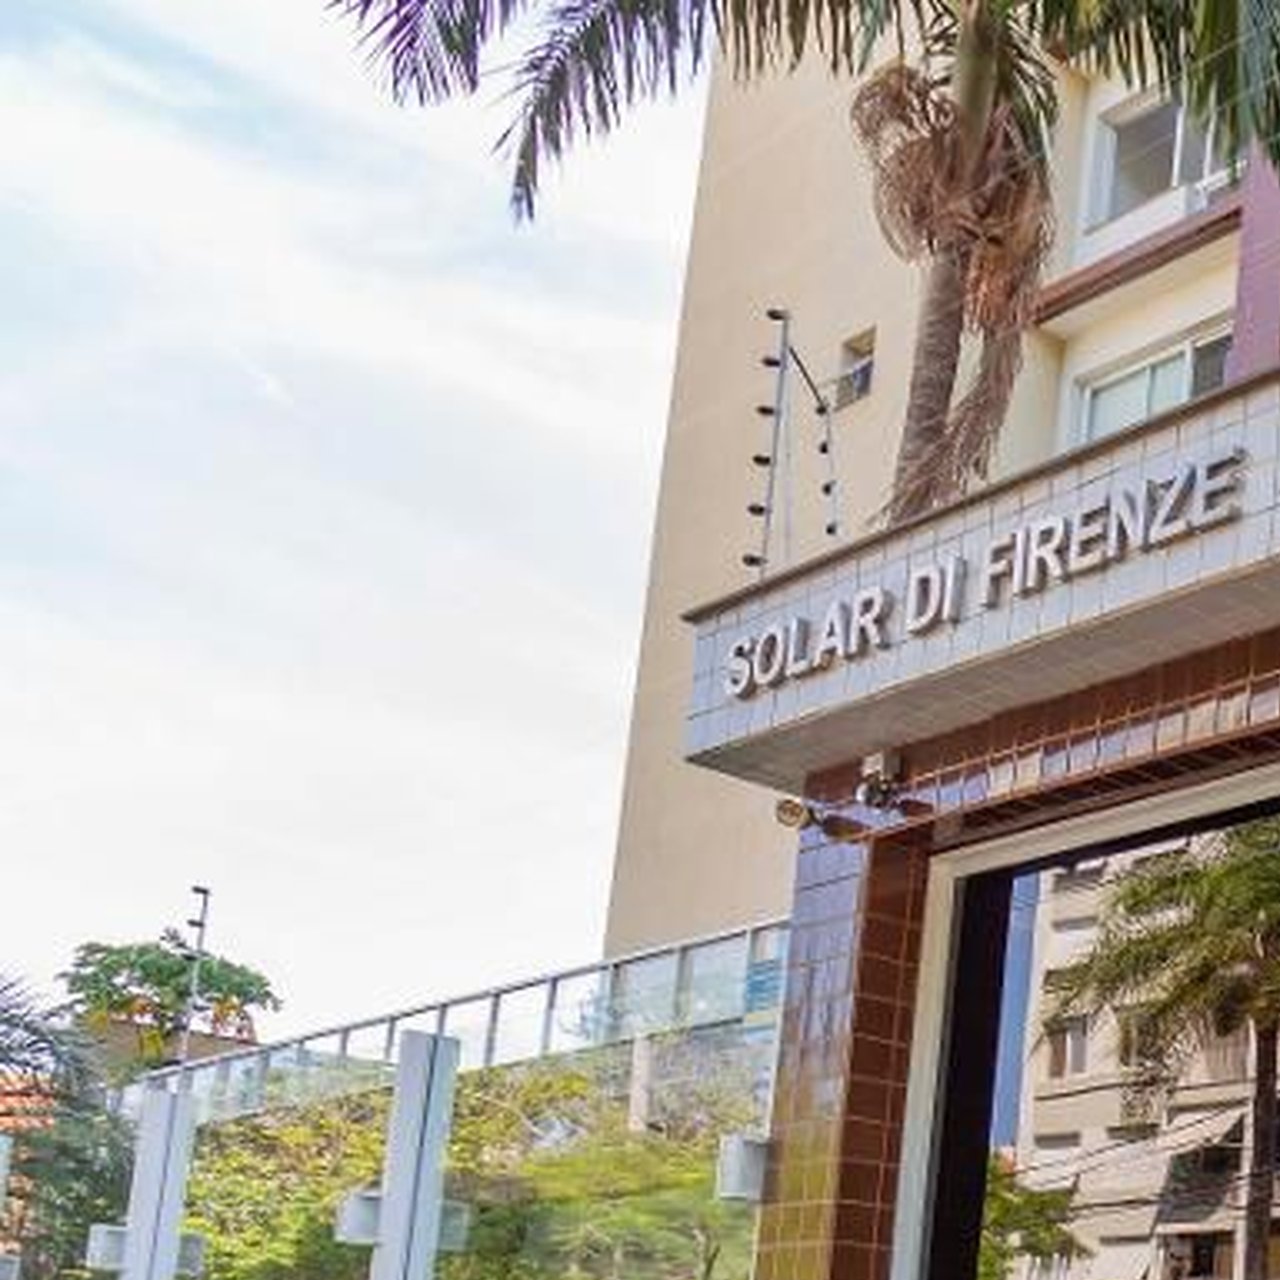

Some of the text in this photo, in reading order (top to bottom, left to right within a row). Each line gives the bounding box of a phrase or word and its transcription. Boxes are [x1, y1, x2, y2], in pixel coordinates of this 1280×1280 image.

[726, 448, 1247, 700] SOLAR DI FIRENZE
